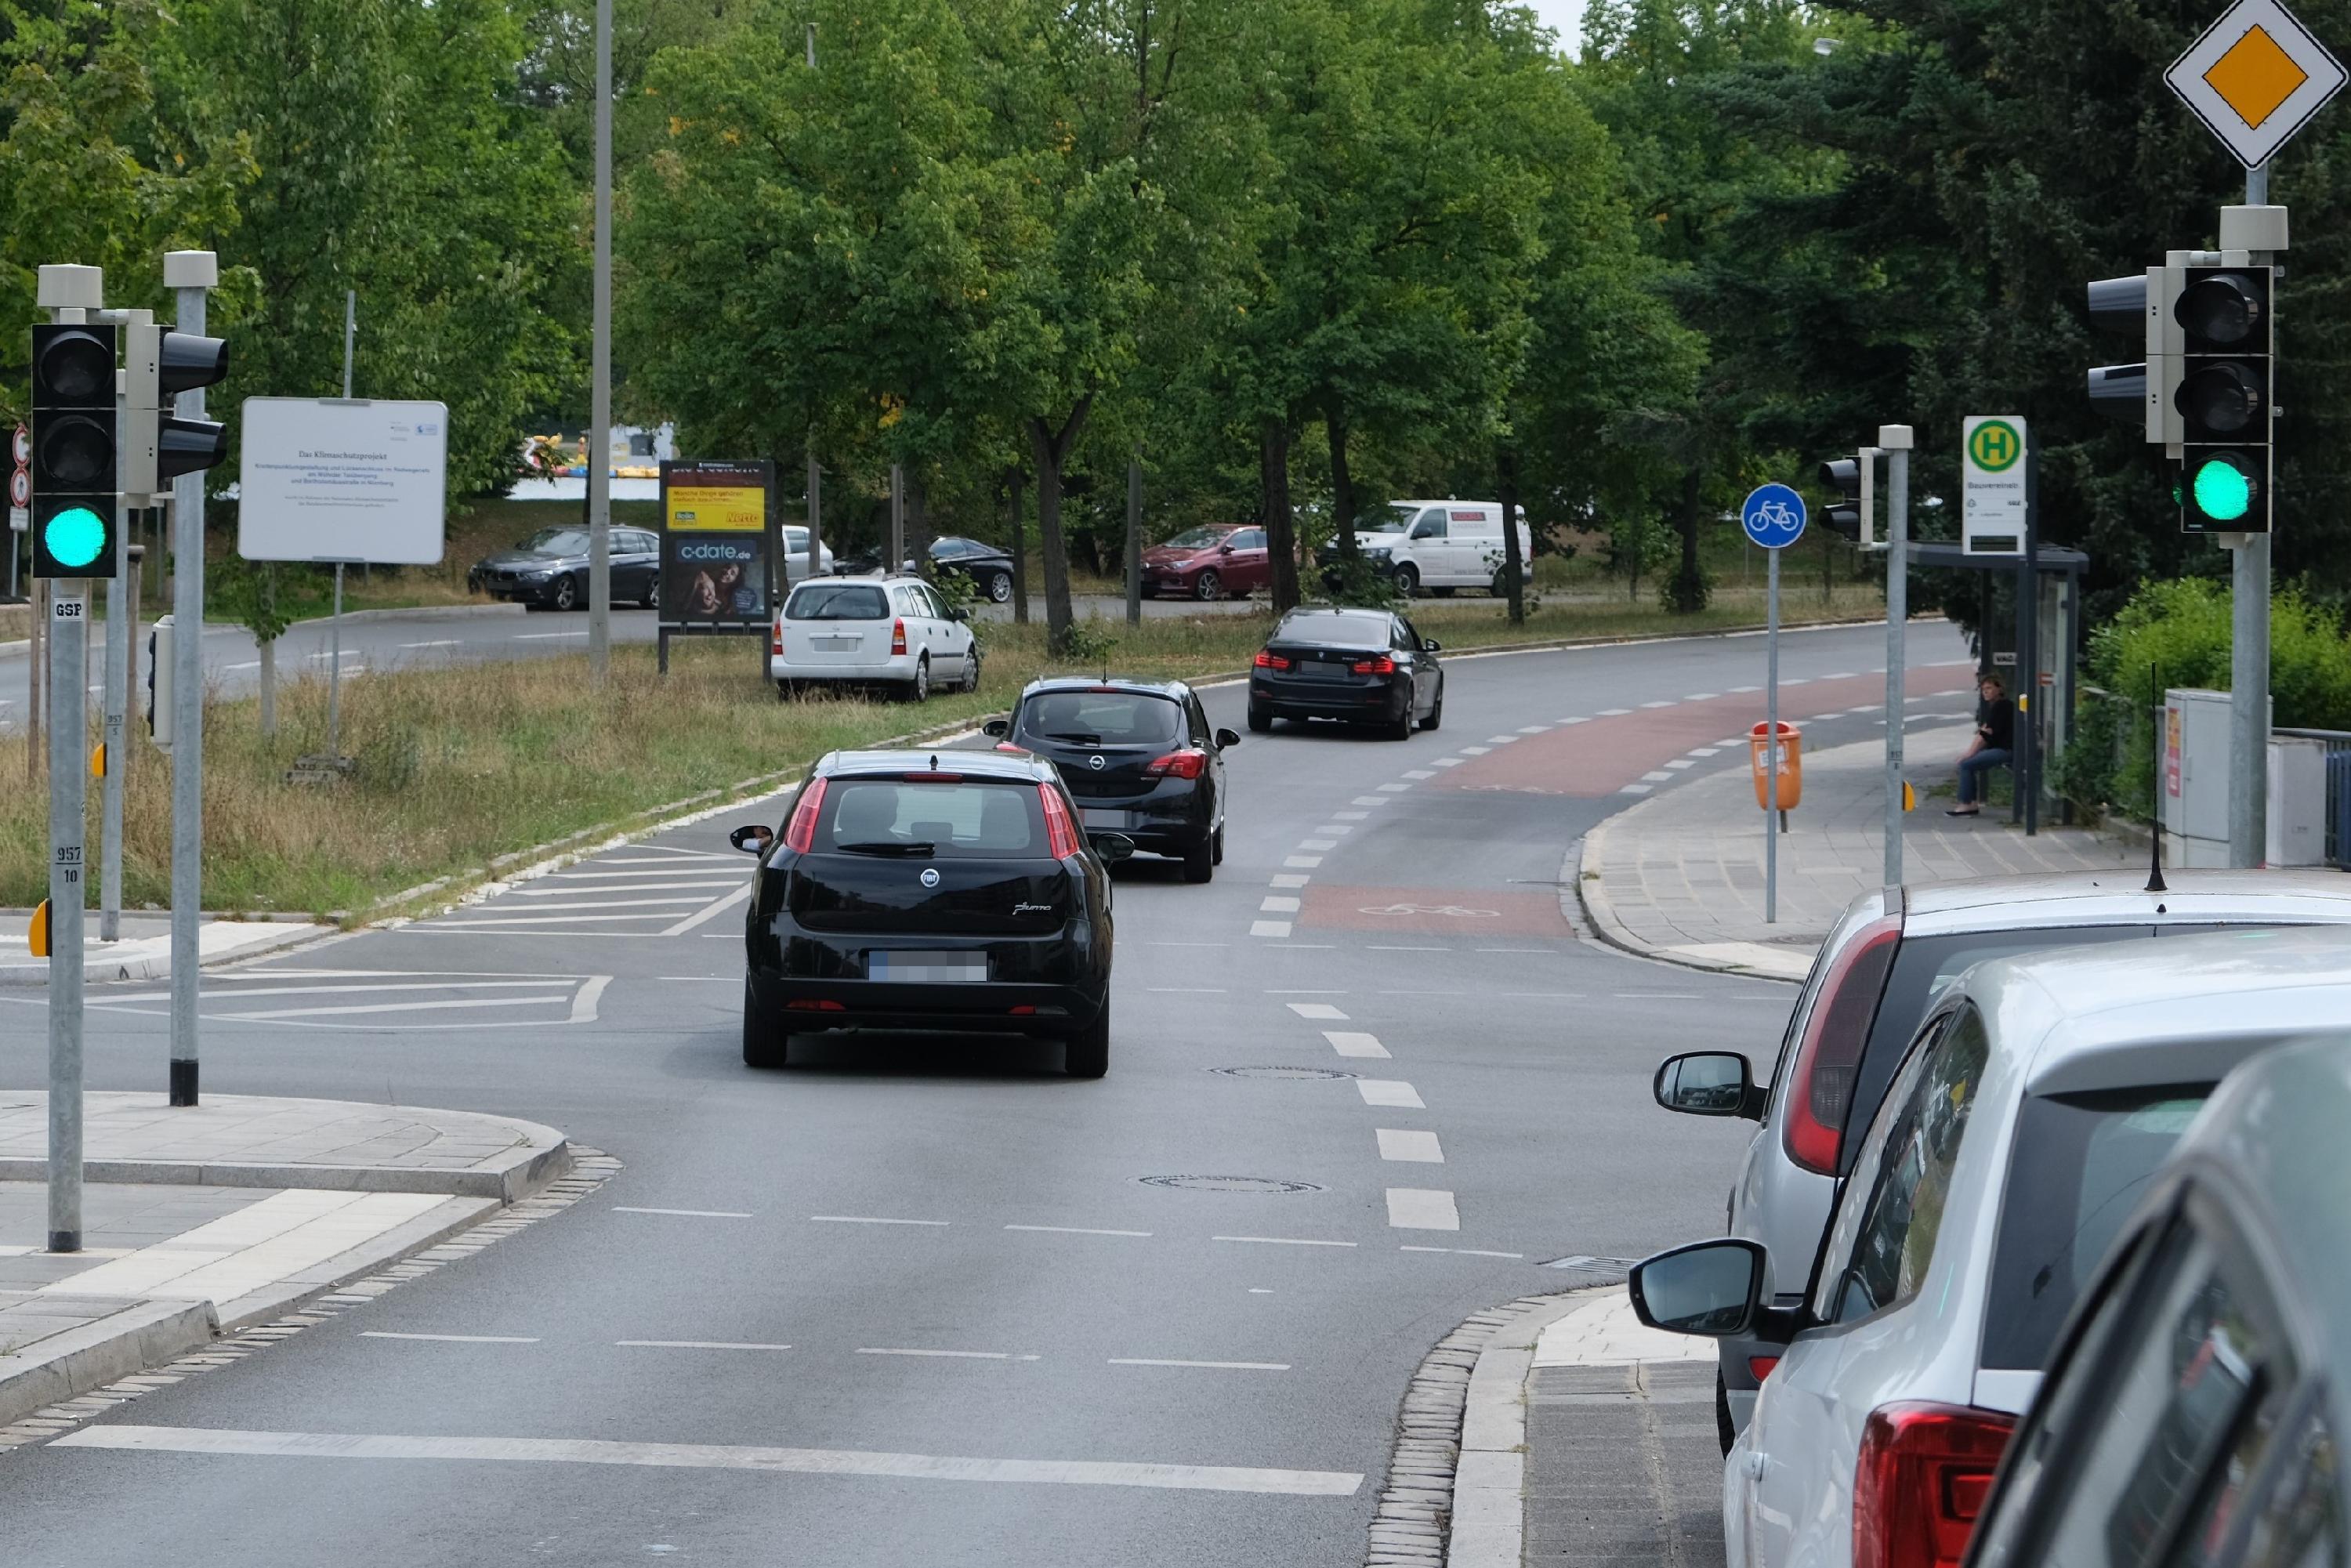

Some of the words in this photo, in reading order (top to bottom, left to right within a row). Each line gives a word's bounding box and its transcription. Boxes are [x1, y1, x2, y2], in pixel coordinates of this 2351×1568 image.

[1983, 433, 2007, 460] H
[313, 451, 387, 461] Klimaschutzprojekt
[726, 511, 759, 523] Netto
[681, 543, 751, 559] c-date.de
[56, 603, 82, 617] GSP
[107, 714, 122, 723] 957
[57, 846, 82, 860] 957
[63, 869, 78, 883] 10
